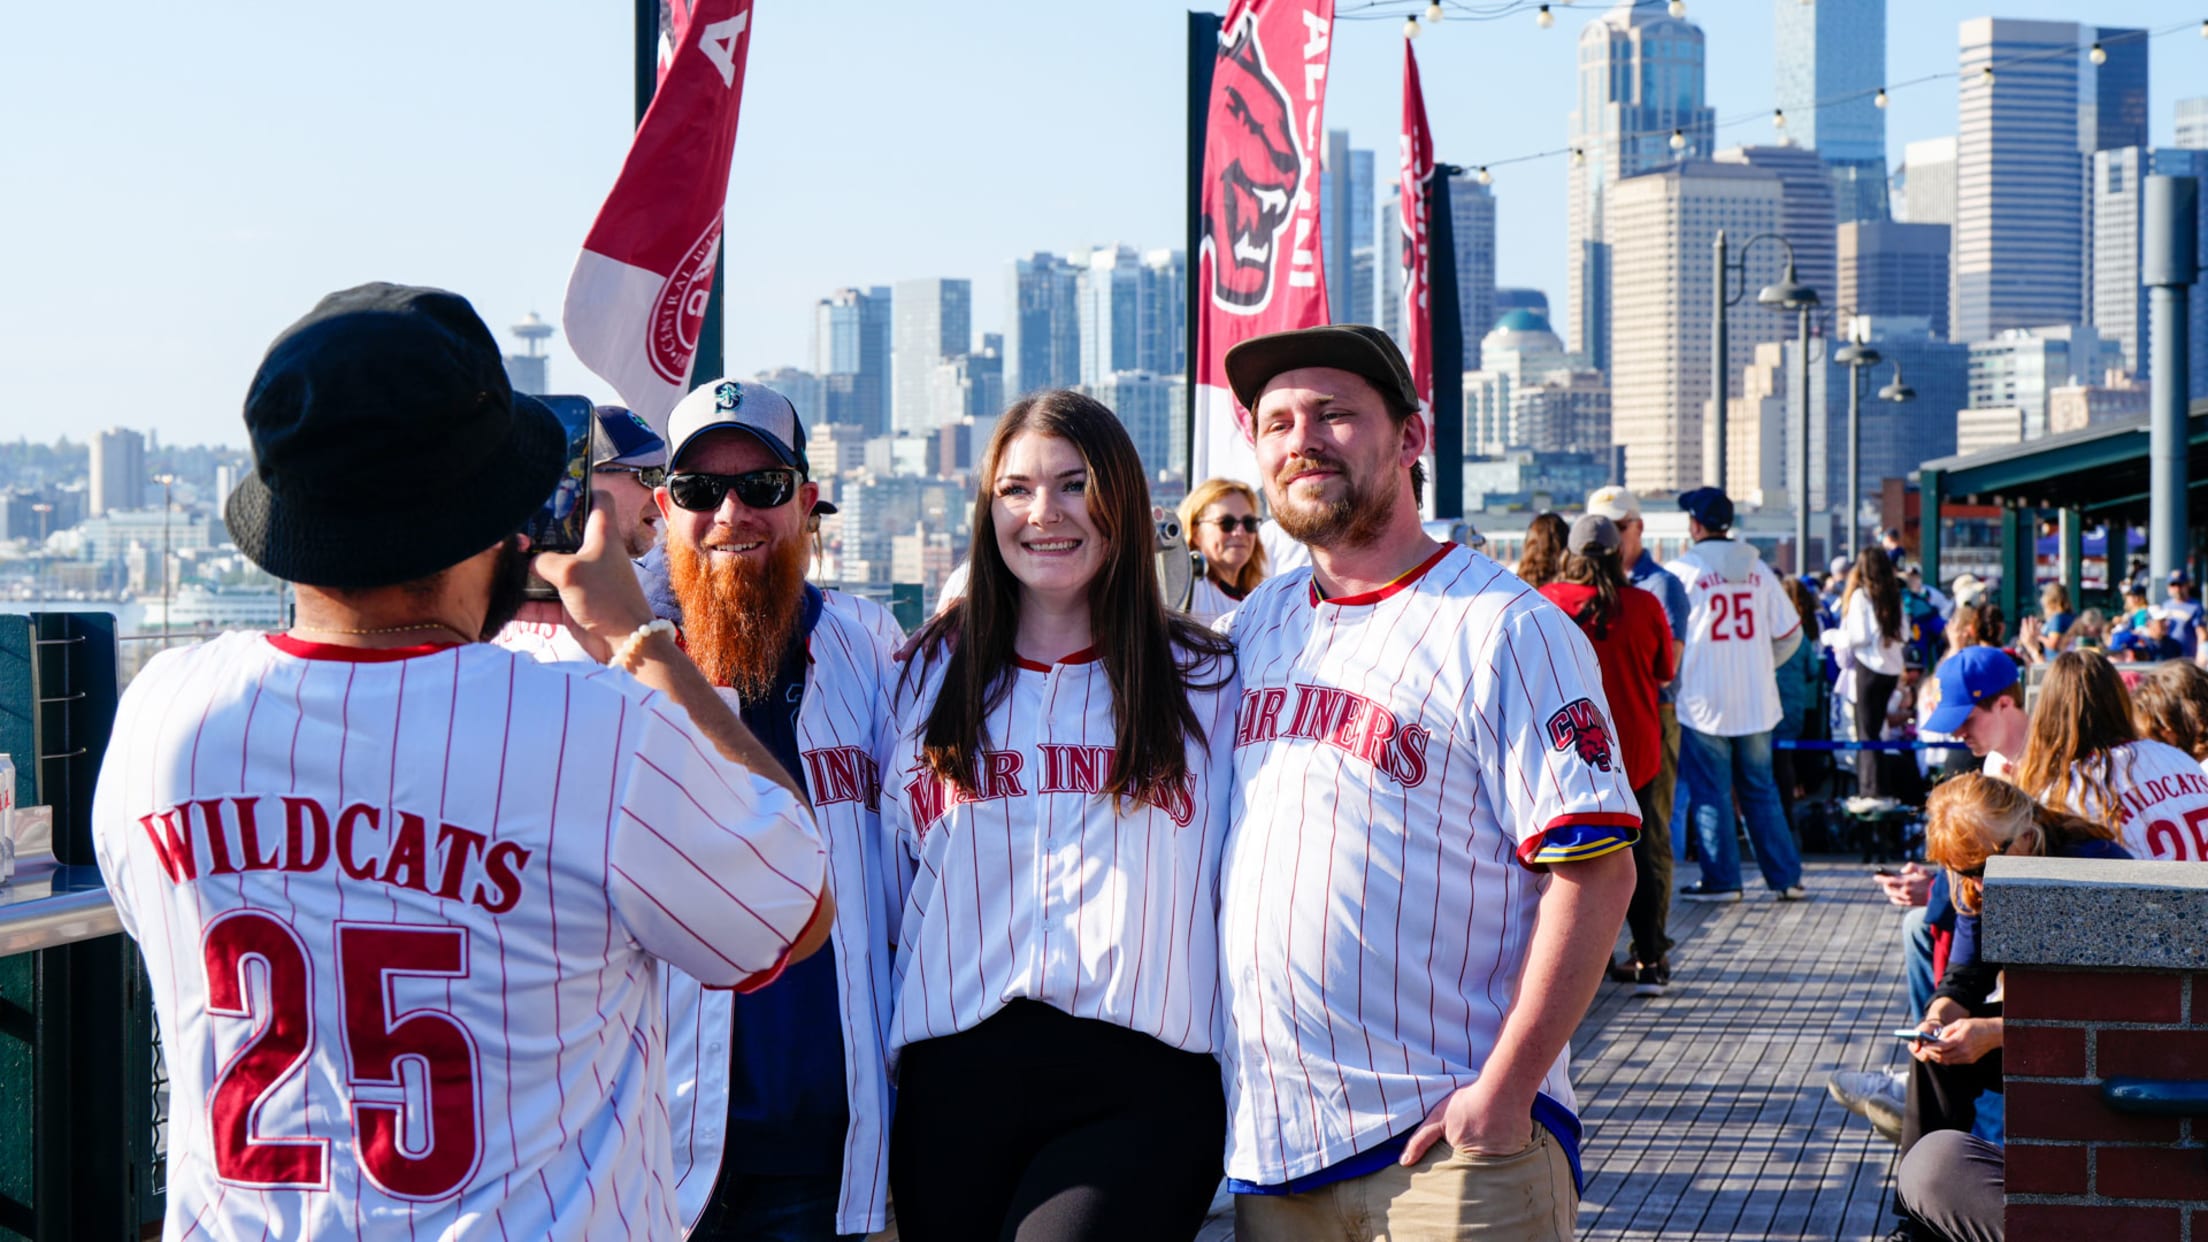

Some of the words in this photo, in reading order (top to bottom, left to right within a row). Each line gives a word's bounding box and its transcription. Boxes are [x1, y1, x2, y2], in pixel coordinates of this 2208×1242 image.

[1709, 592, 1755, 641] 25
[1234, 683, 1431, 788] ARINERS
[139, 795, 532, 914] WILDCATS
[200, 908, 486, 1202] 25
